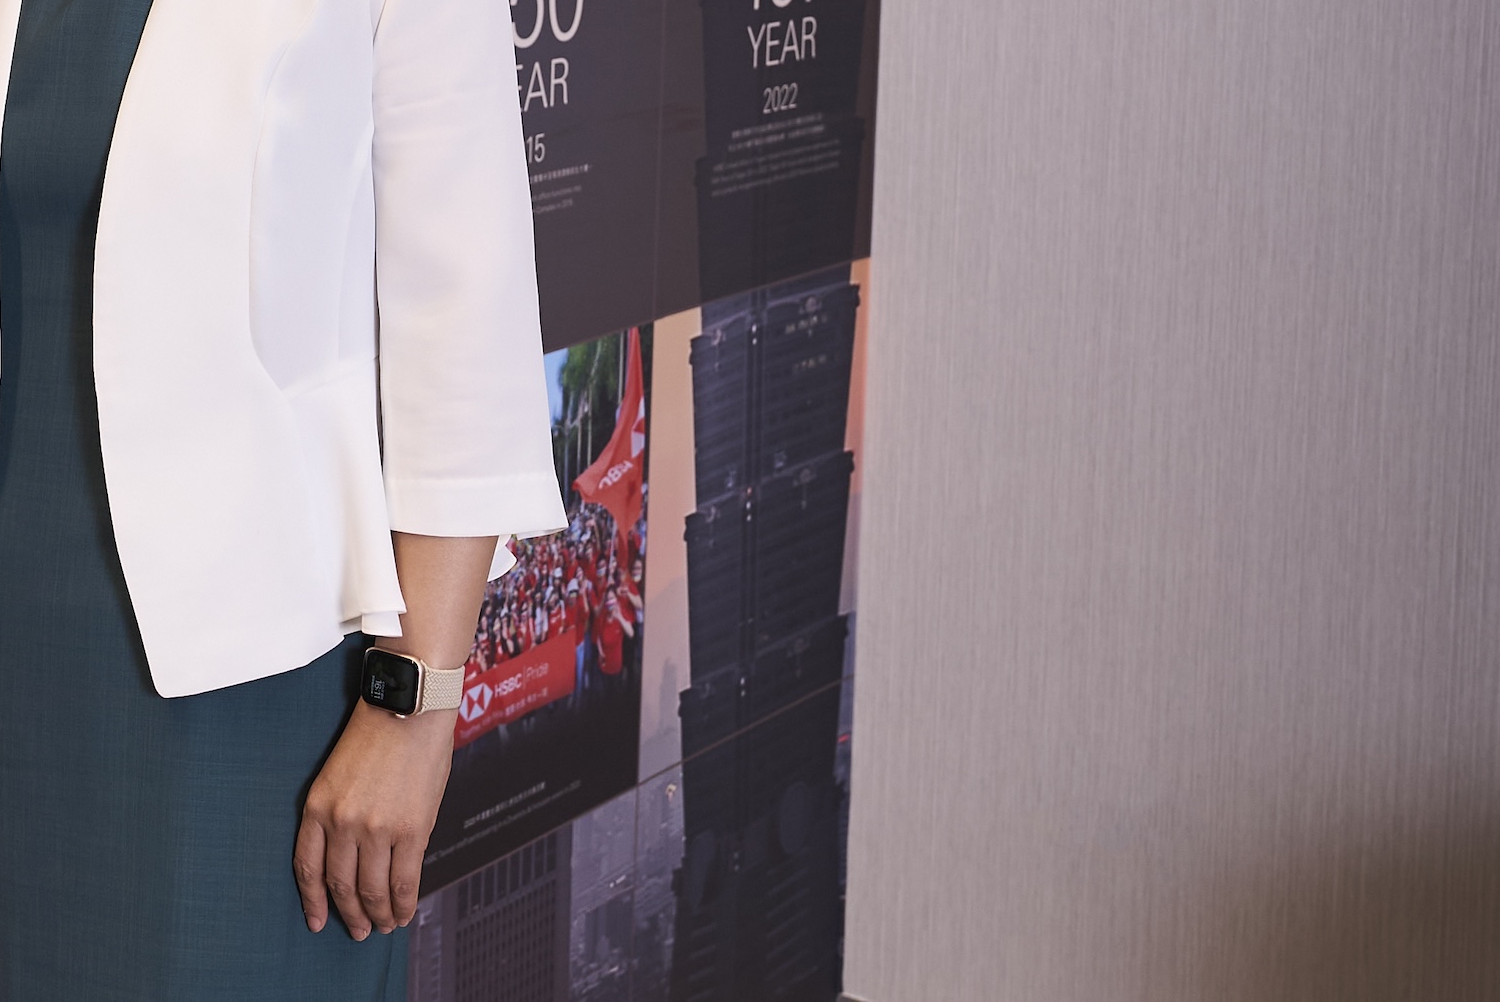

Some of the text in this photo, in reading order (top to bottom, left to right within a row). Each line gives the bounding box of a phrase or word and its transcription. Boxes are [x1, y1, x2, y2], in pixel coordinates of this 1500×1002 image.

[747, 16, 817, 70] YEAR
[763, 82, 798, 114] 2022
[526, 133, 546, 164] 15
[495, 673, 522, 698] HSBC
